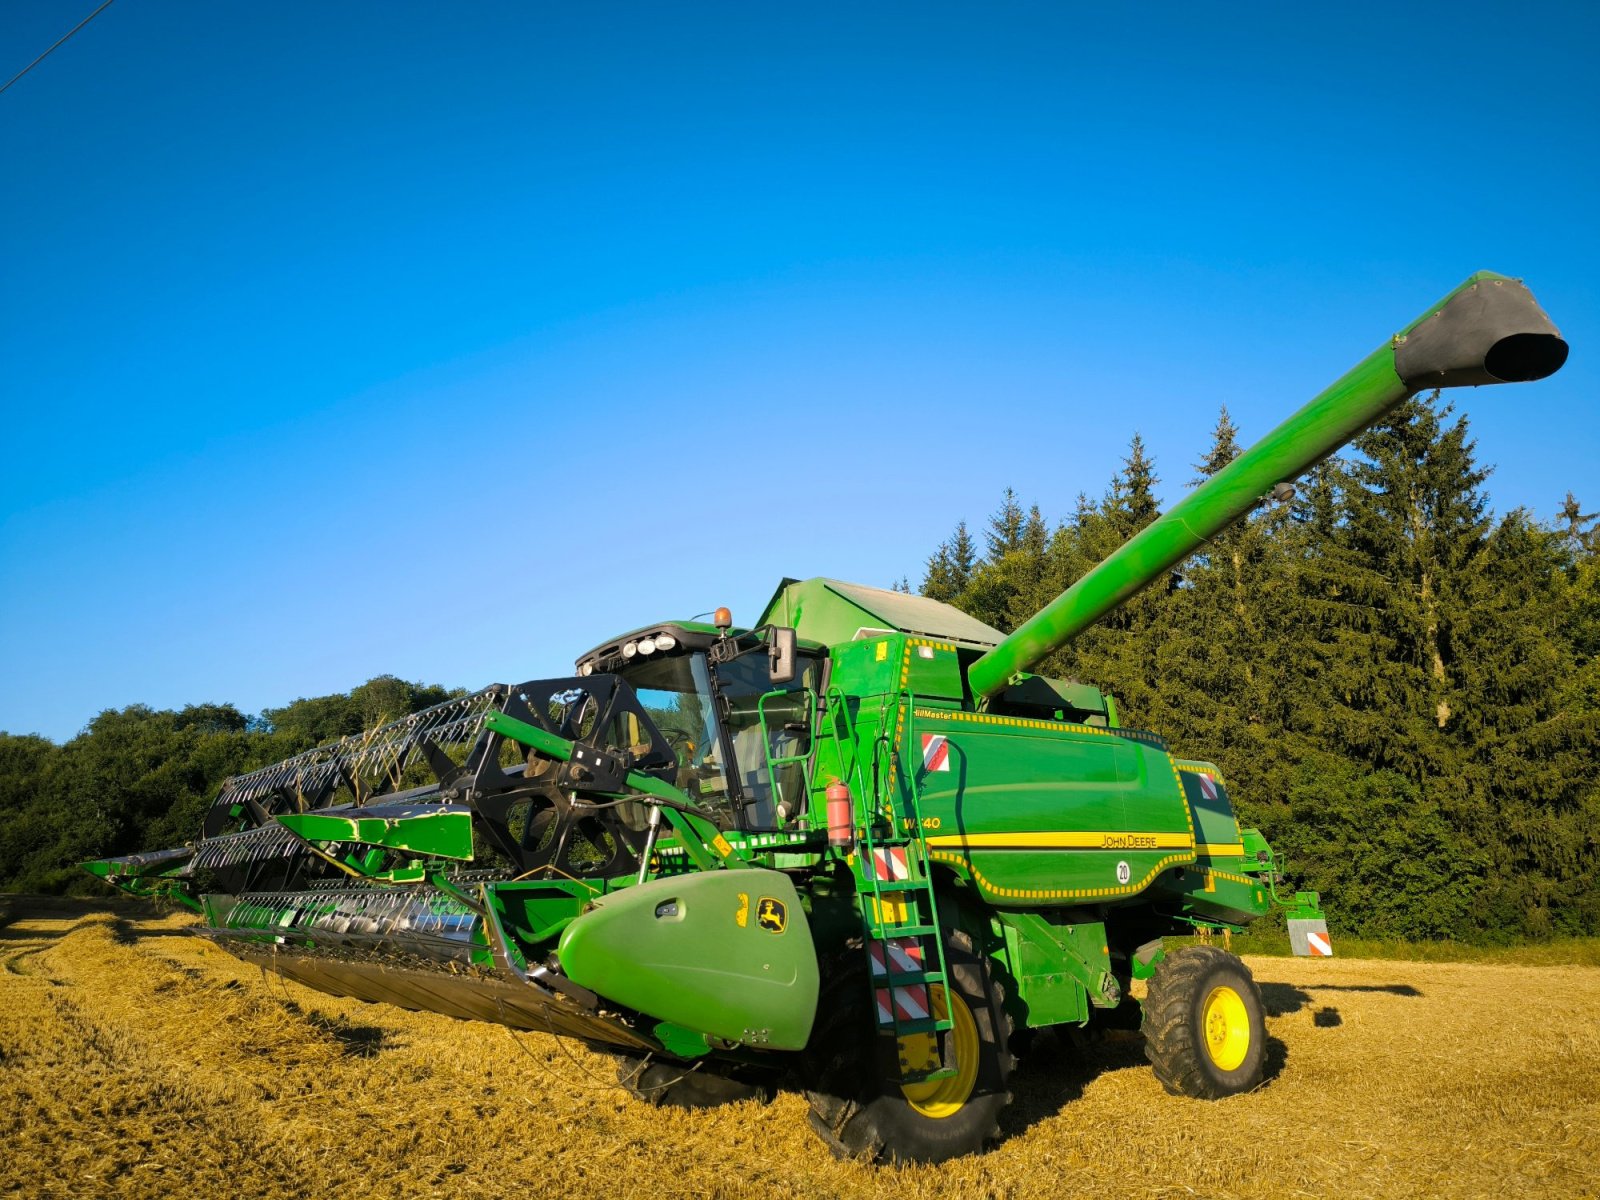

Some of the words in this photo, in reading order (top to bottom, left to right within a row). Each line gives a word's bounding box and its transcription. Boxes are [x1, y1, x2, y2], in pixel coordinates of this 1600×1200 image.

[904, 817, 940, 829] W40
[1101, 834, 1126, 847] JOHN
[1128, 834, 1157, 847] DEERE
[1119, 865, 1128, 880] 20
